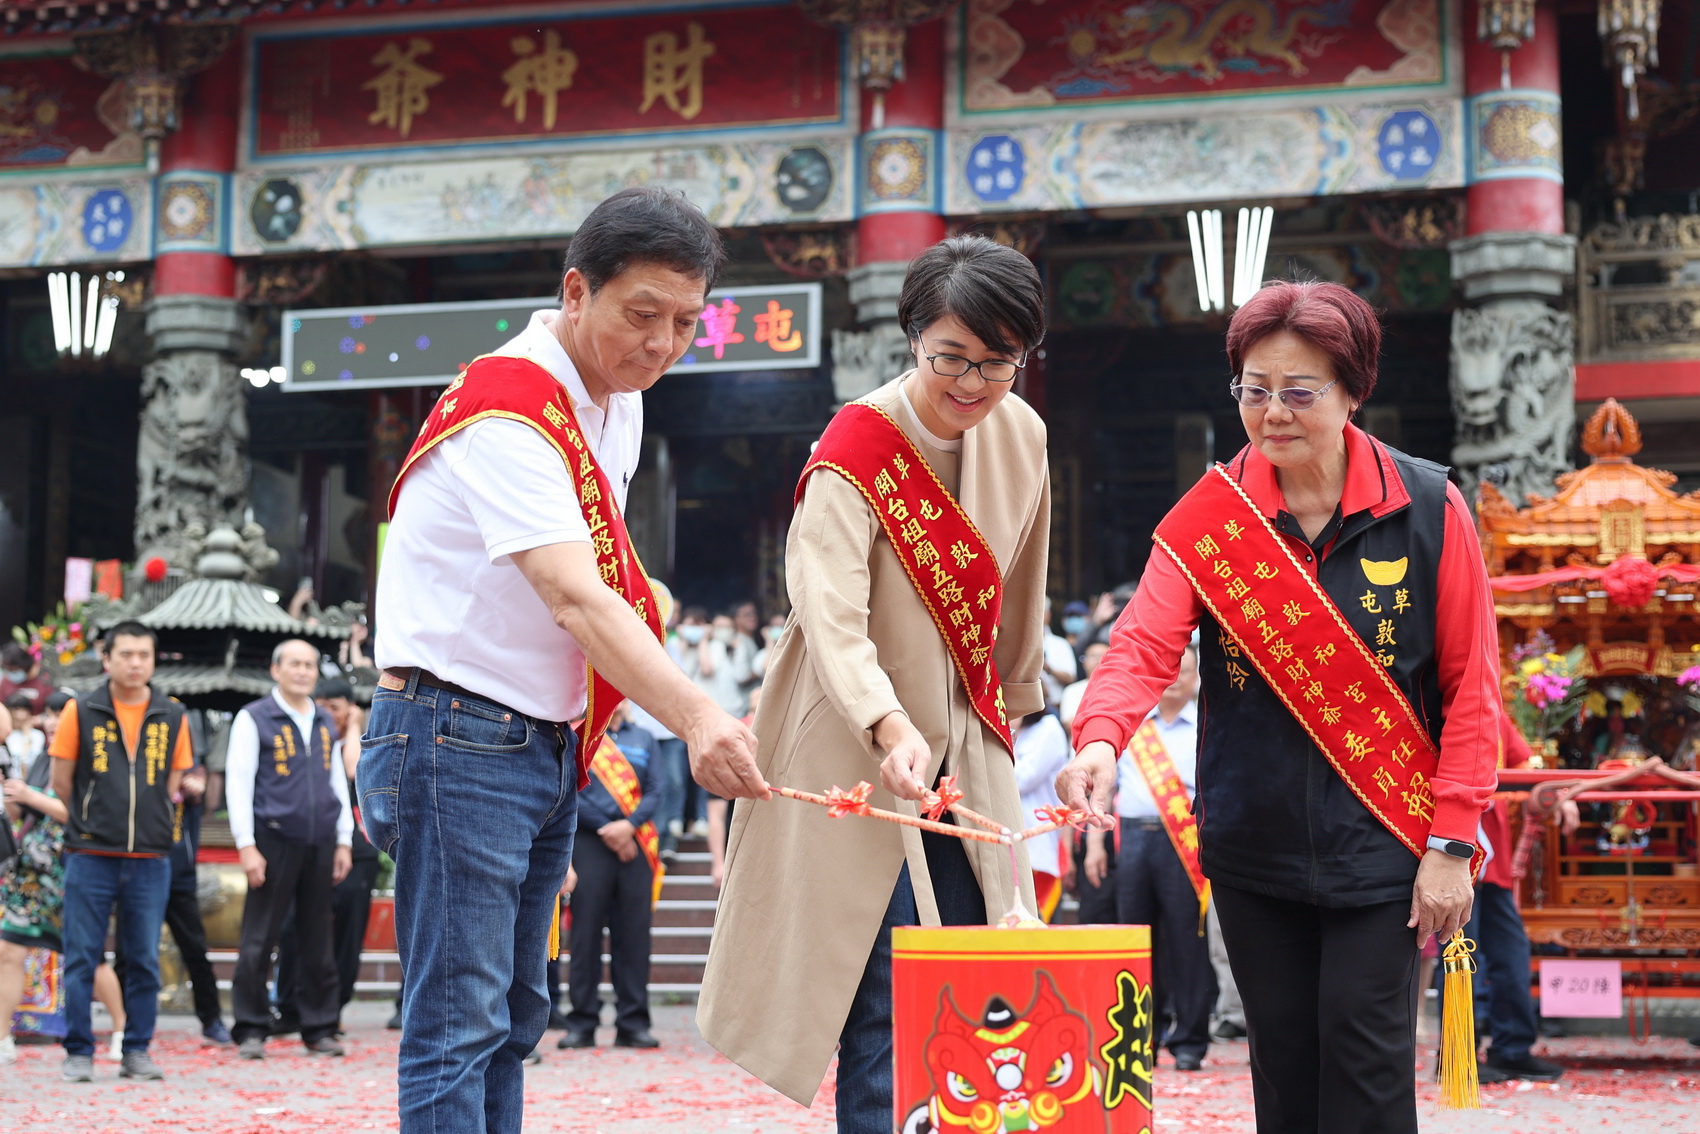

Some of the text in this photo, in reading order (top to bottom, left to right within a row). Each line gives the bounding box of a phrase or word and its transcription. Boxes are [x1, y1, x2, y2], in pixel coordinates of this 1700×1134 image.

[694, 298, 803, 359] 草屯
[874, 468, 990, 667] 開台祖廟五路財神爺
[893, 453, 998, 640] 草屯敦和
